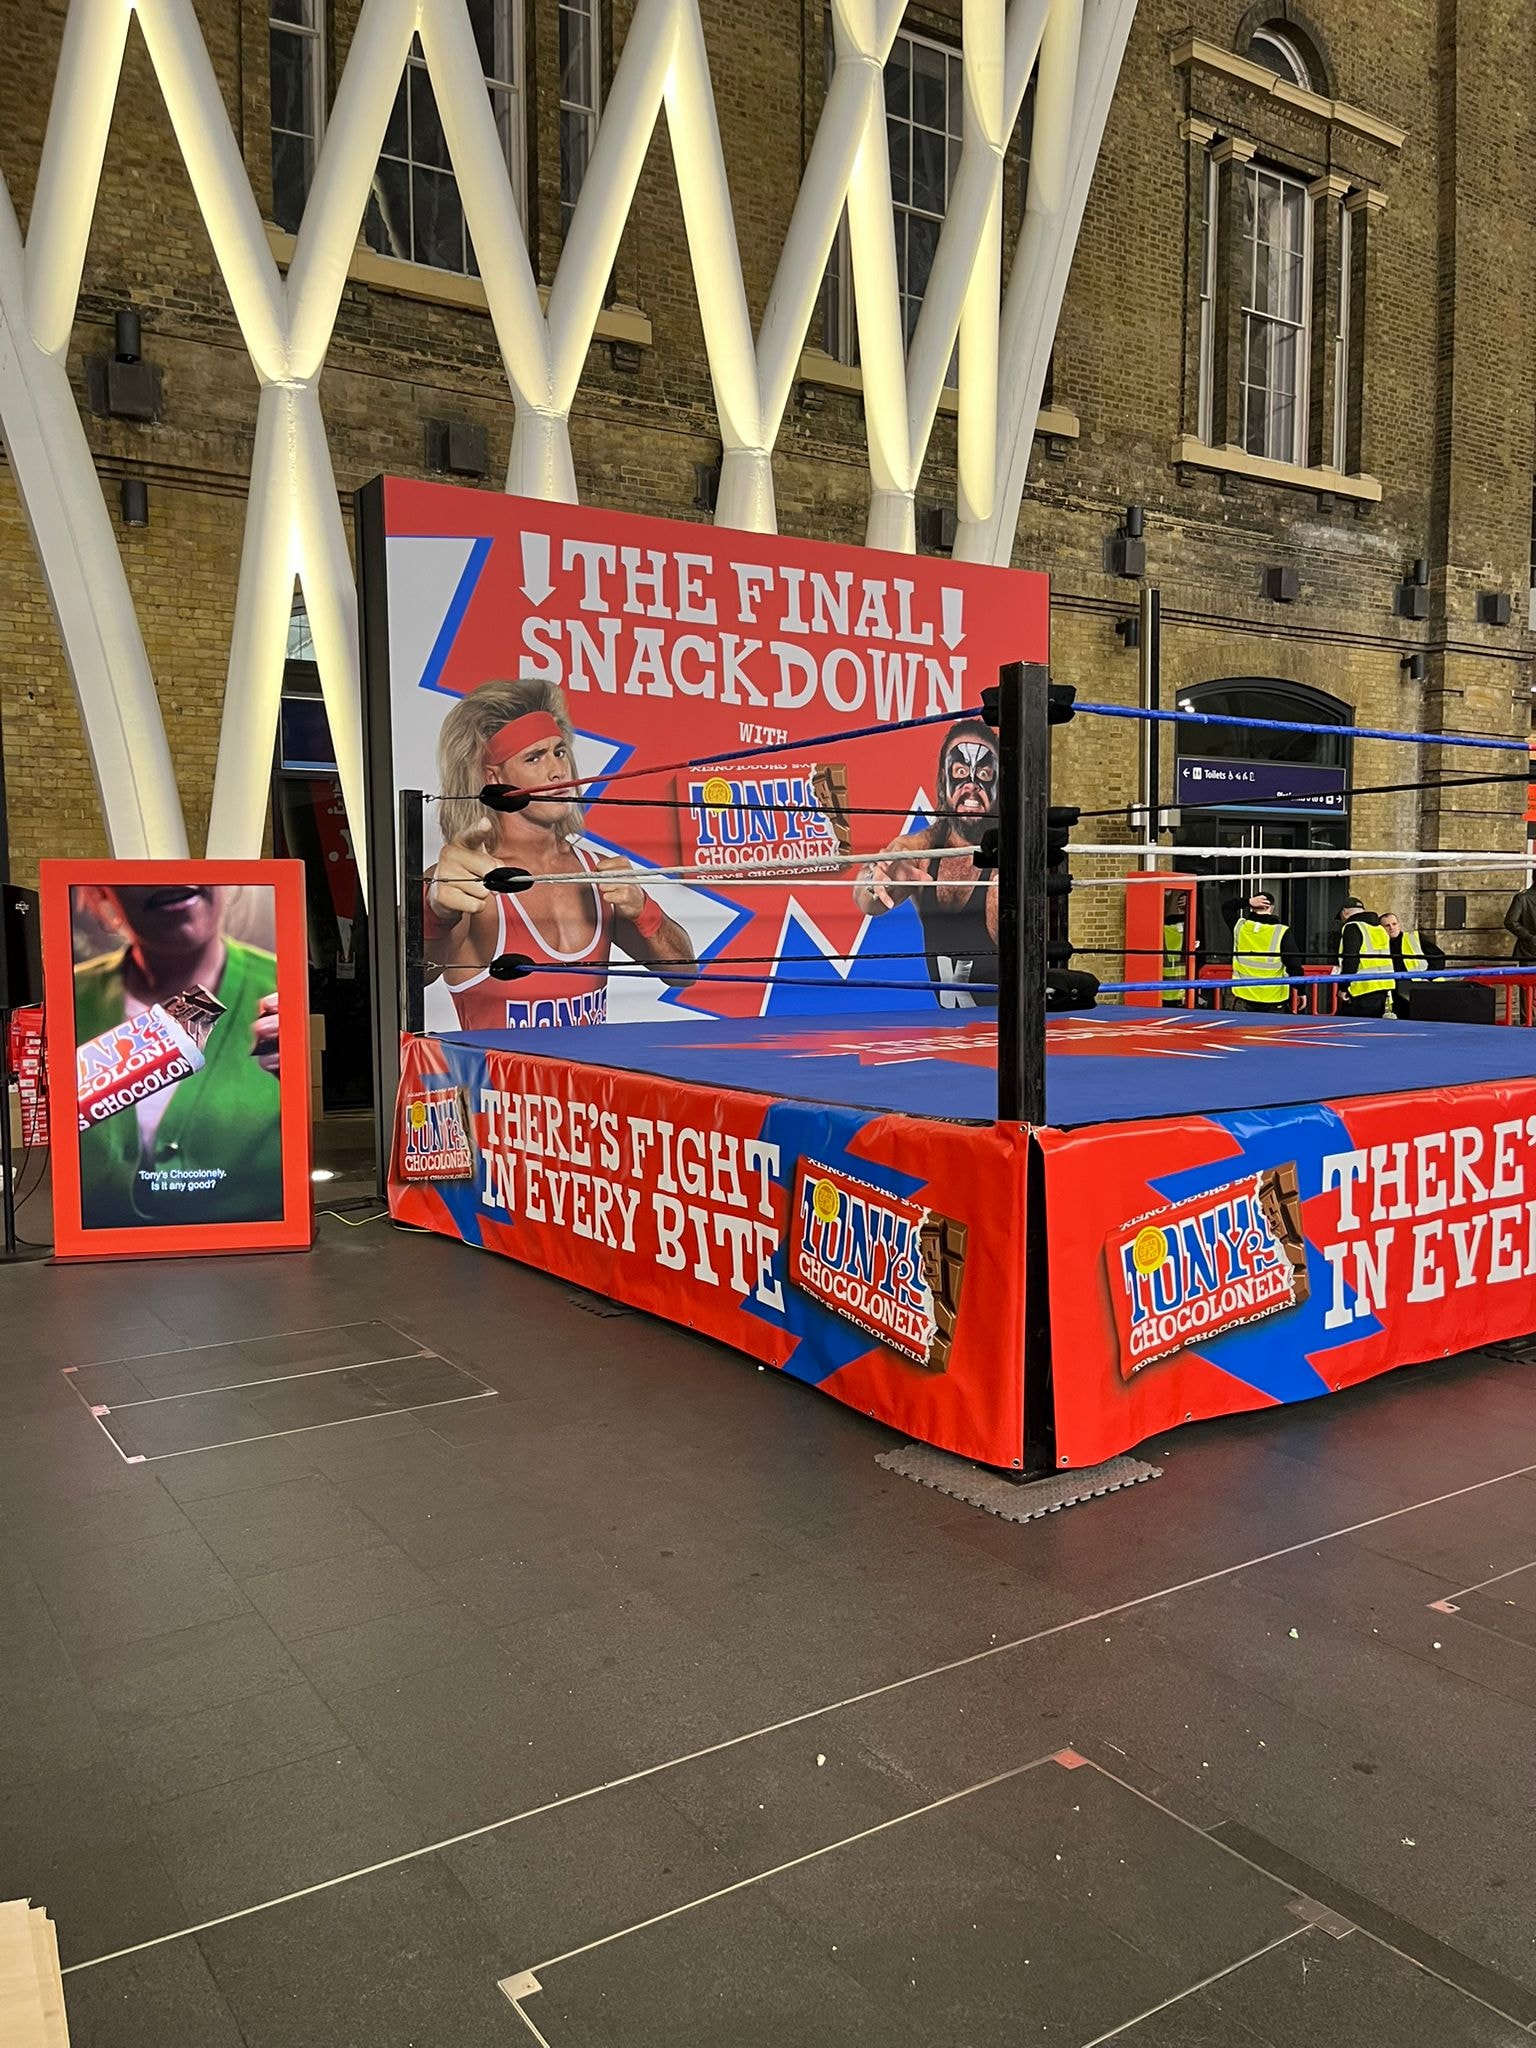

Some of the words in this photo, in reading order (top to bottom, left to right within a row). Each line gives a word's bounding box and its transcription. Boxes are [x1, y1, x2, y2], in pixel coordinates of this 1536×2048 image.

[562, 539, 718, 625] THE
[730, 561, 934, 646] FINAL
[519, 616, 968, 722] SNACKDOWN
[738, 721, 788, 745] WITH
[688, 778, 831, 846] TONY'S
[1204, 769, 1227, 781] Toilets
[694, 839, 839, 867] CHOCOLONELY
[404, 1150, 472, 1172] CHOCOLONELY
[405, 1100, 468, 1155] TONY'S
[480, 1088, 620, 1172] THERE'S
[627, 1115, 780, 1219] FIGHT
[139, 1170, 168, 1181] Tony's
[169, 1168, 227, 1179] Chocolonely.
[151, 1181, 160, 1191] Is
[169, 1181, 186, 1192] any
[187, 1179, 216, 1192] good?
[481, 1148, 518, 1212] IN
[525, 1158, 641, 1253] EVERY
[652, 1192, 785, 1313] BITE
[801, 1173, 929, 1313] TONY'S
[1119, 1194, 1284, 1327] TONY'S
[1324, 1224, 1396, 1330] IN
[1406, 1200, 1536, 1303] EVE
[799, 1252, 936, 1346] CHOCOLONELY
[1129, 1264, 1295, 1357] CHOCOLONELY
[1183, 1299, 1297, 1347] CHOCOLONELY
